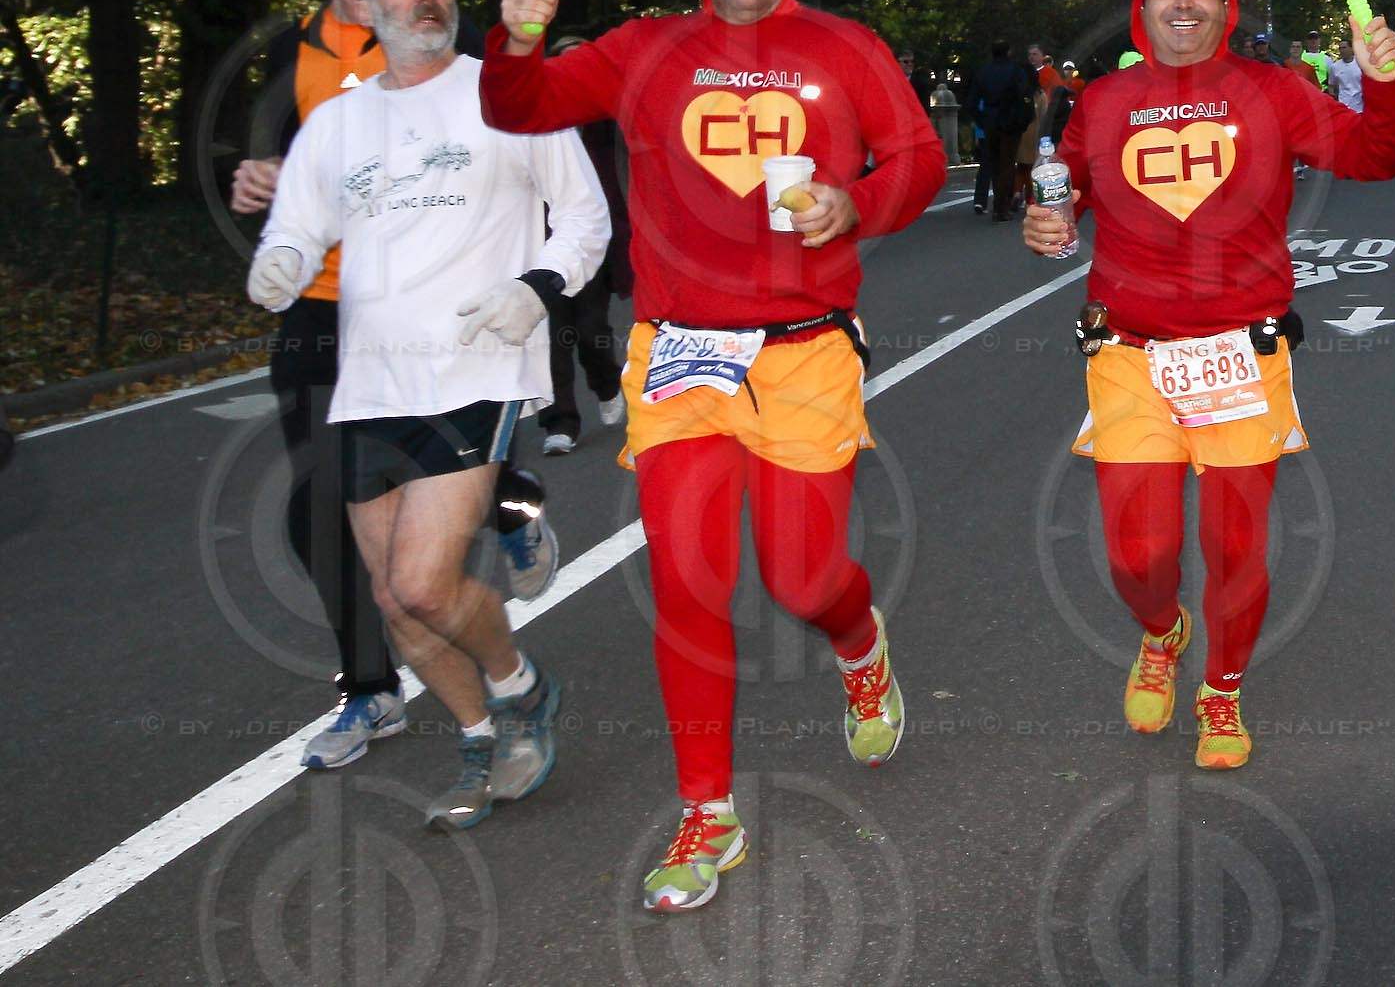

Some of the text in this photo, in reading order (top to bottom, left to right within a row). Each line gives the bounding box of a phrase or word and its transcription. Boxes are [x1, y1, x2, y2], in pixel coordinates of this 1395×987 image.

[693, 68, 802, 88] MEXICALI
[1130, 101, 1228, 126] MEXICALI
[700, 115, 790, 155] CH
[1137, 140, 1222, 185] CH
[422, 195, 466, 208] BEACH
[1168, 343, 1209, 362] ING
[1161, 352, 1249, 395] 63-698
